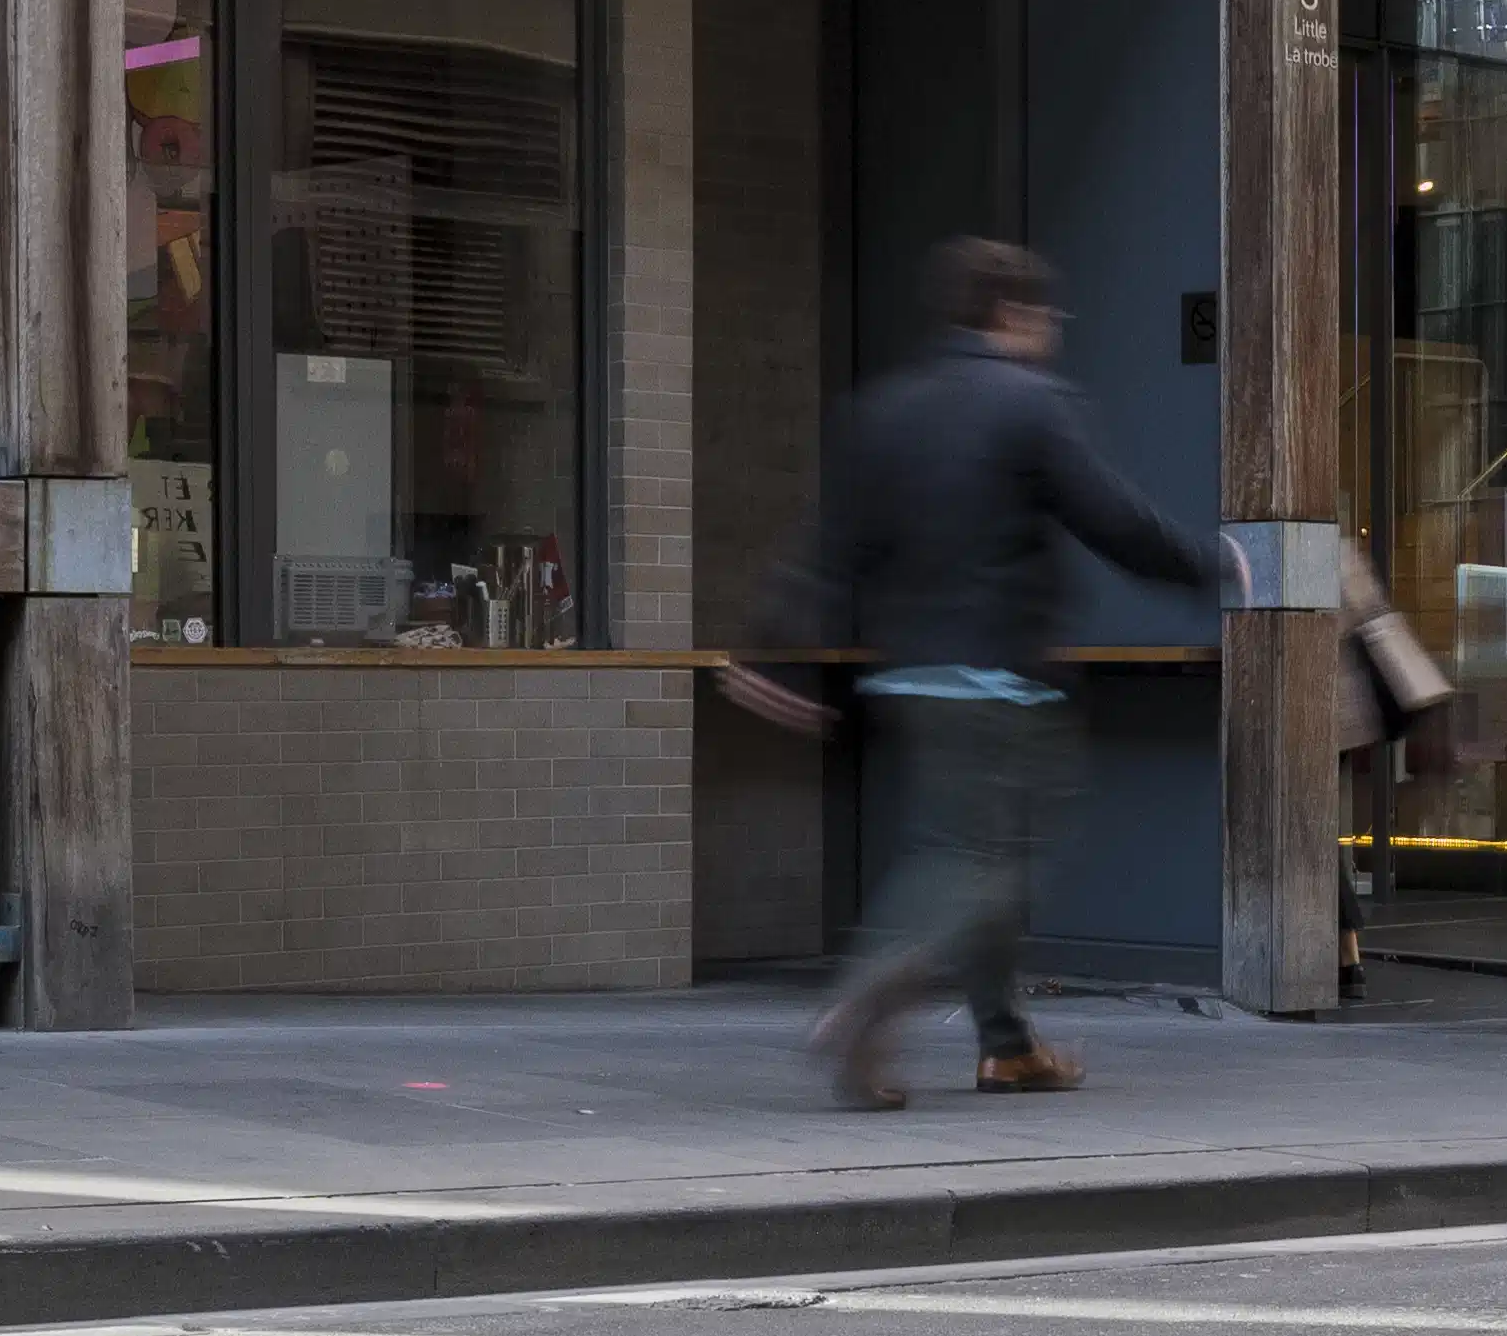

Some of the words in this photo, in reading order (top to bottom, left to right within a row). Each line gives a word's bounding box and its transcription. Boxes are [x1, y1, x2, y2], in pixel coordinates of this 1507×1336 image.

[1293, 15, 1327, 40] Little
[1284, 42, 1301, 65] La
[1304, 48, 1339, 70] trobe
